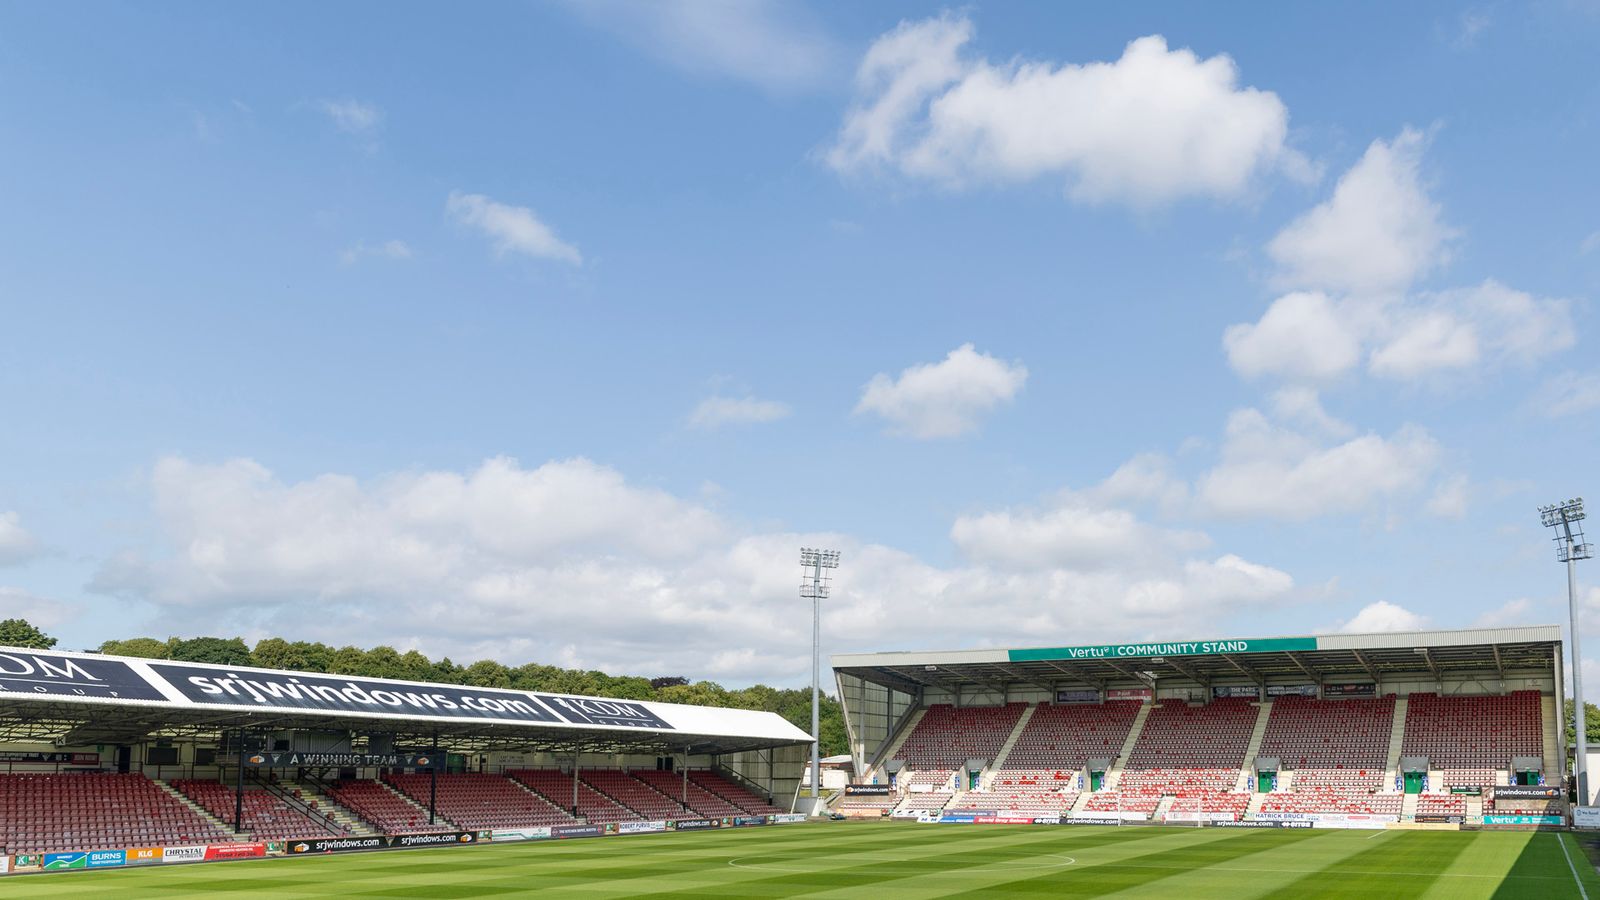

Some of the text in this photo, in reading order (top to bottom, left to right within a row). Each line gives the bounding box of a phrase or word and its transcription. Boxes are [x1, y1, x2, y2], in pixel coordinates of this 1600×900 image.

[1068, 641, 1248, 658] Vertu COMMUNITY STAND
[187, 673, 539, 715] srjwindows.com
[567, 699, 648, 717] KDM
[290, 753, 398, 765] A WINNING TEAM
[1495, 788, 1546, 796] srjwindows.com
[316, 838, 380, 851] srjwindows.com
[402, 834, 457, 846] srjwindows.com
[91, 853, 122, 861] BURNS
[138, 850, 153, 858] KLG
[165, 848, 203, 857] CHRYSTAL
